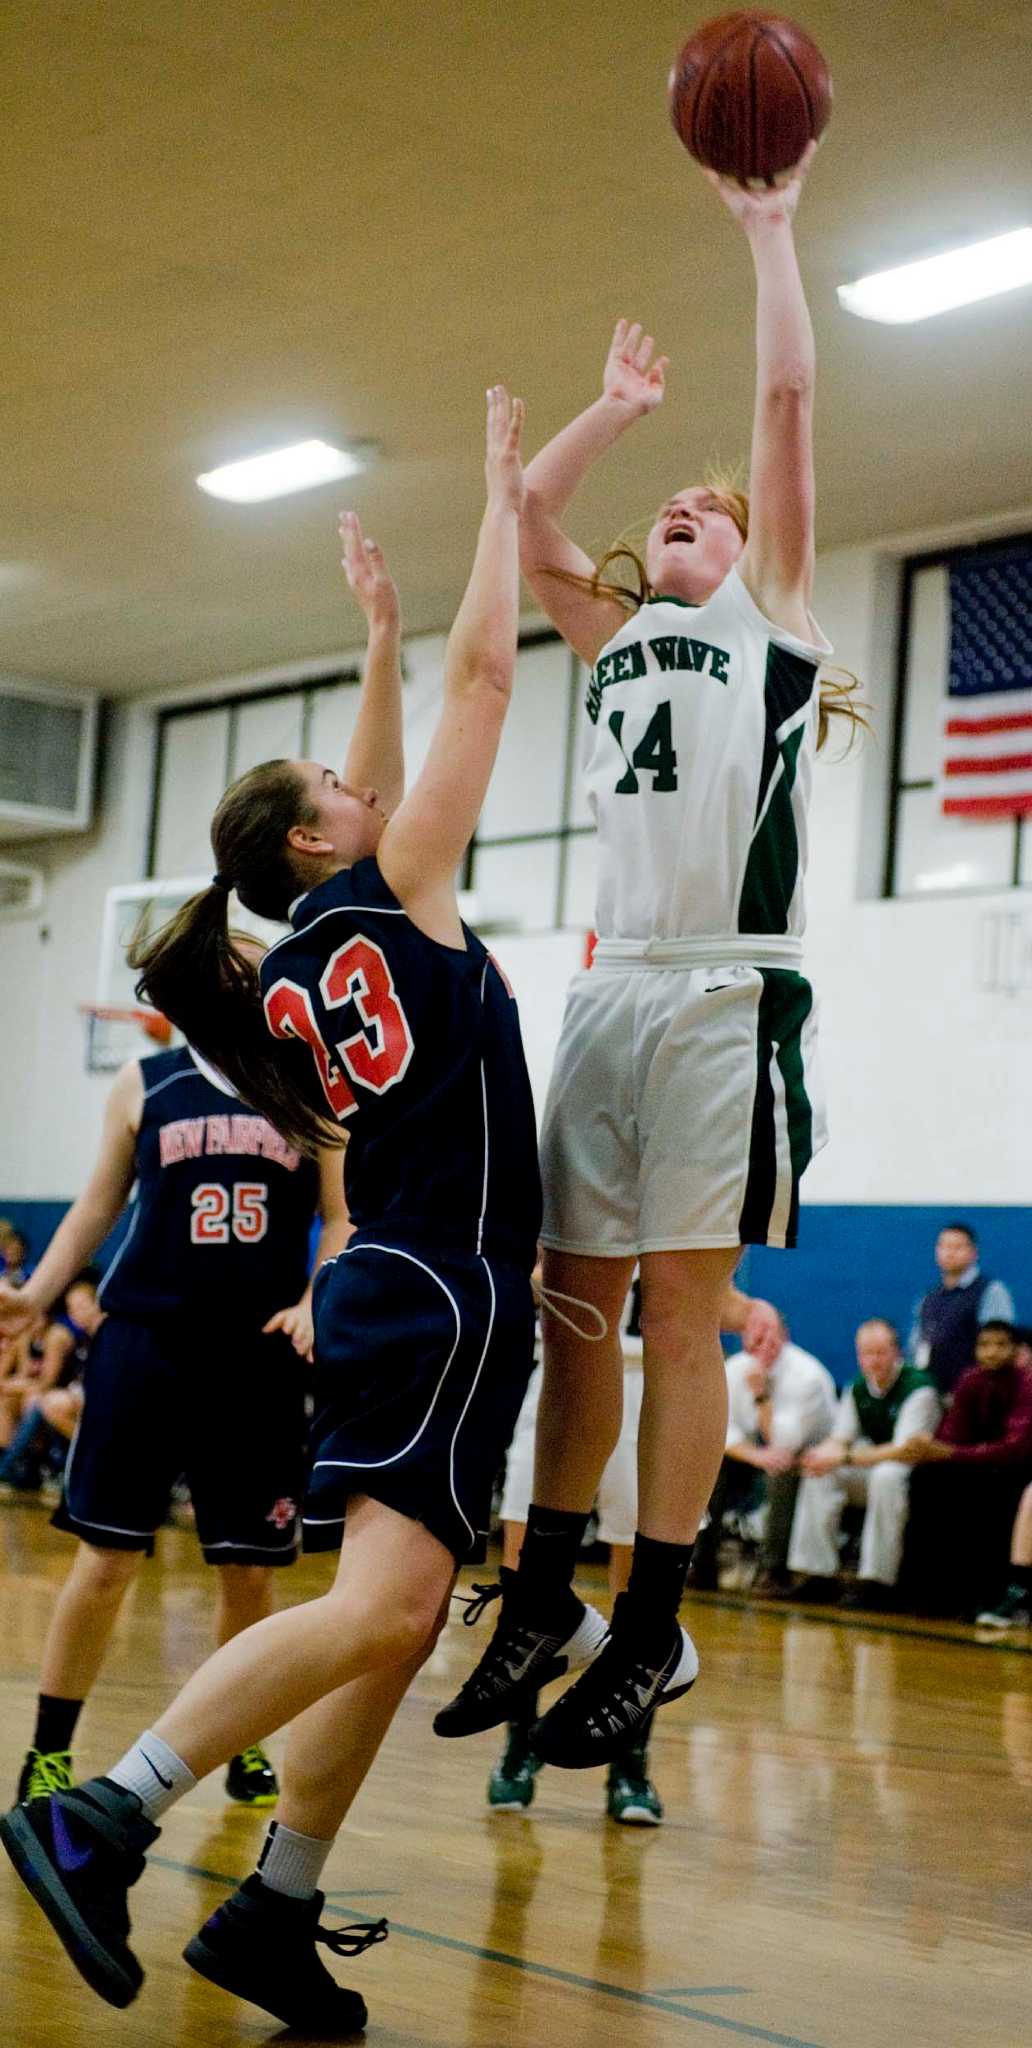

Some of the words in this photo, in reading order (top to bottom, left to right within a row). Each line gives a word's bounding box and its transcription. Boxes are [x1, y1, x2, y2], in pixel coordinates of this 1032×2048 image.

[648, 635, 731, 686] WAVE
[608, 699, 678, 794] 14
[263, 932, 415, 1122] 23
[159, 1116, 207, 1169] NEW
[190, 1182, 268, 1244] 25
